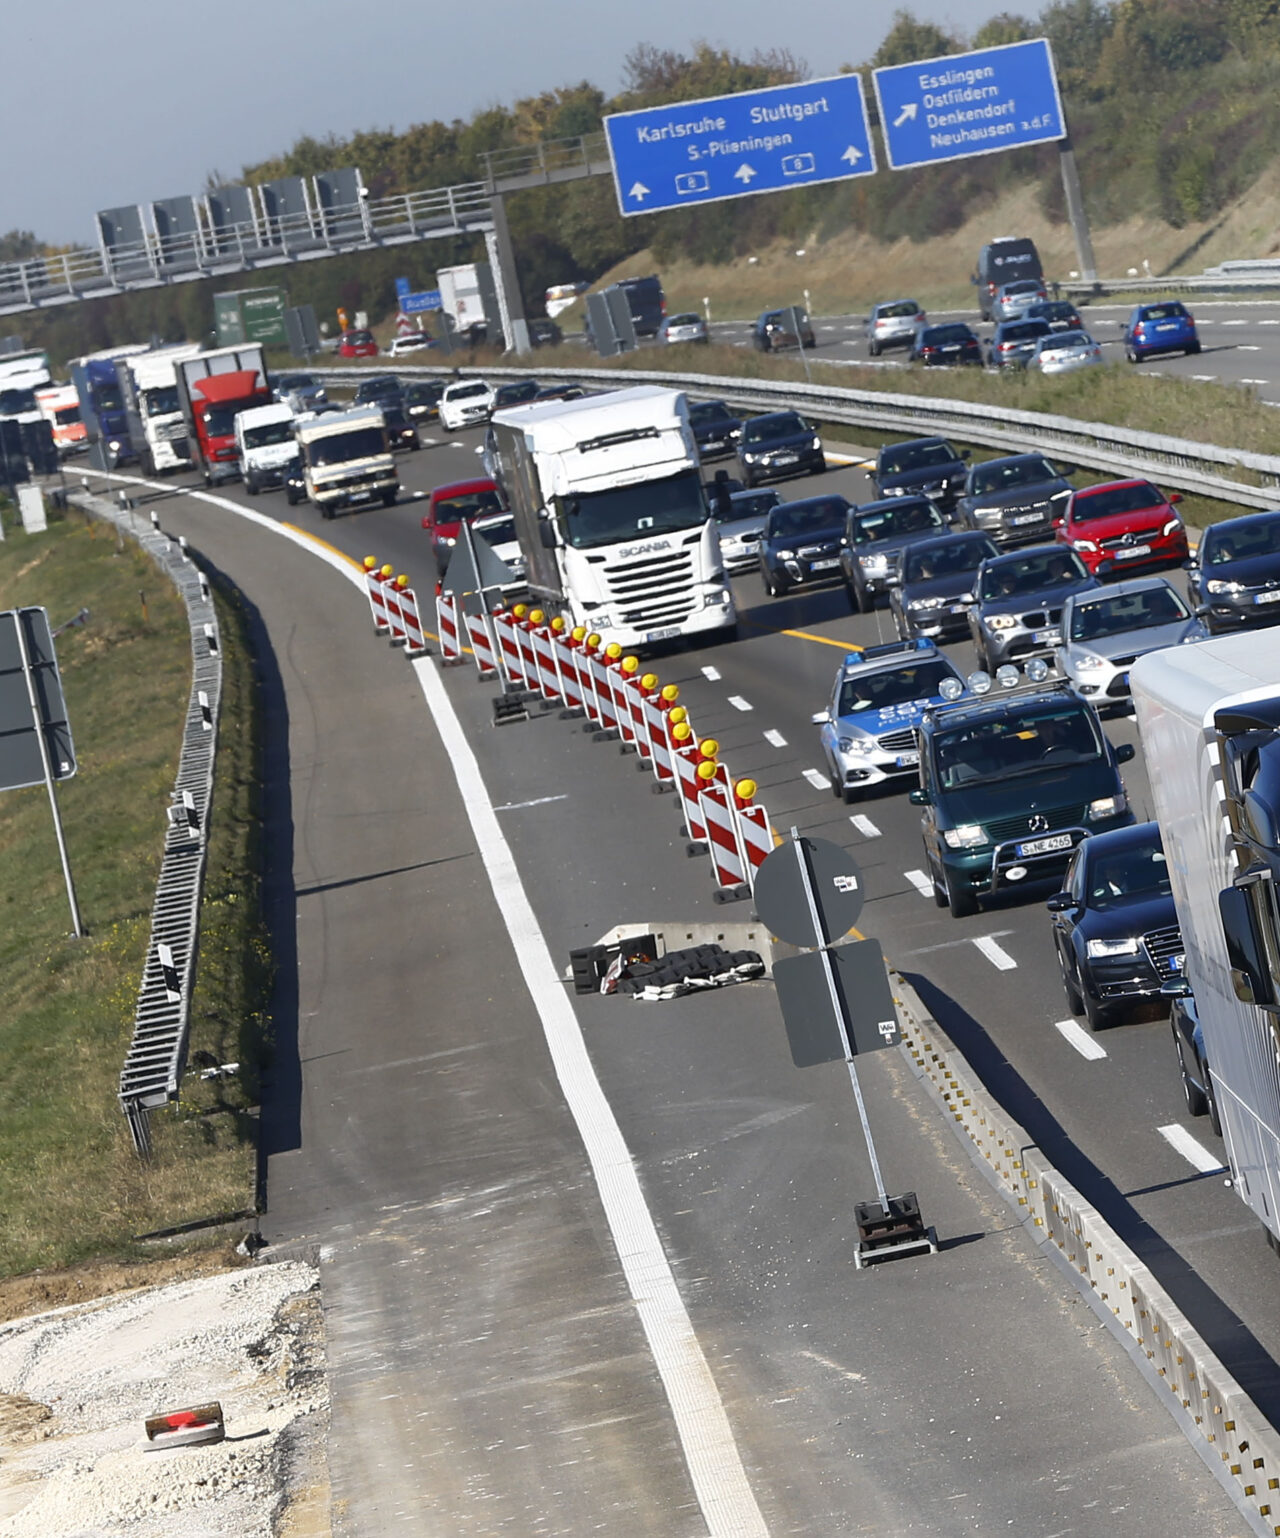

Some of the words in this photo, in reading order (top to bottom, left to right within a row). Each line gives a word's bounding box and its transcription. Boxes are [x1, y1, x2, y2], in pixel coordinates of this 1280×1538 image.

[918, 66, 994, 90] Esslingen
[923, 85, 999, 109] Ostfildern
[636, 116, 727, 144] Karlsruhe
[750, 97, 830, 124] Stuttgart
[926, 100, 1016, 129] Denkendorf
[688, 132, 793, 161] S.-Plieningen
[930, 122, 1015, 149] Neuhausen
[618, 540, 672, 559] SCANIA
[1022, 845, 1030, 855] S
[1034, 841, 1048, 852] NE
[1048, 835, 1071, 848] 4265
